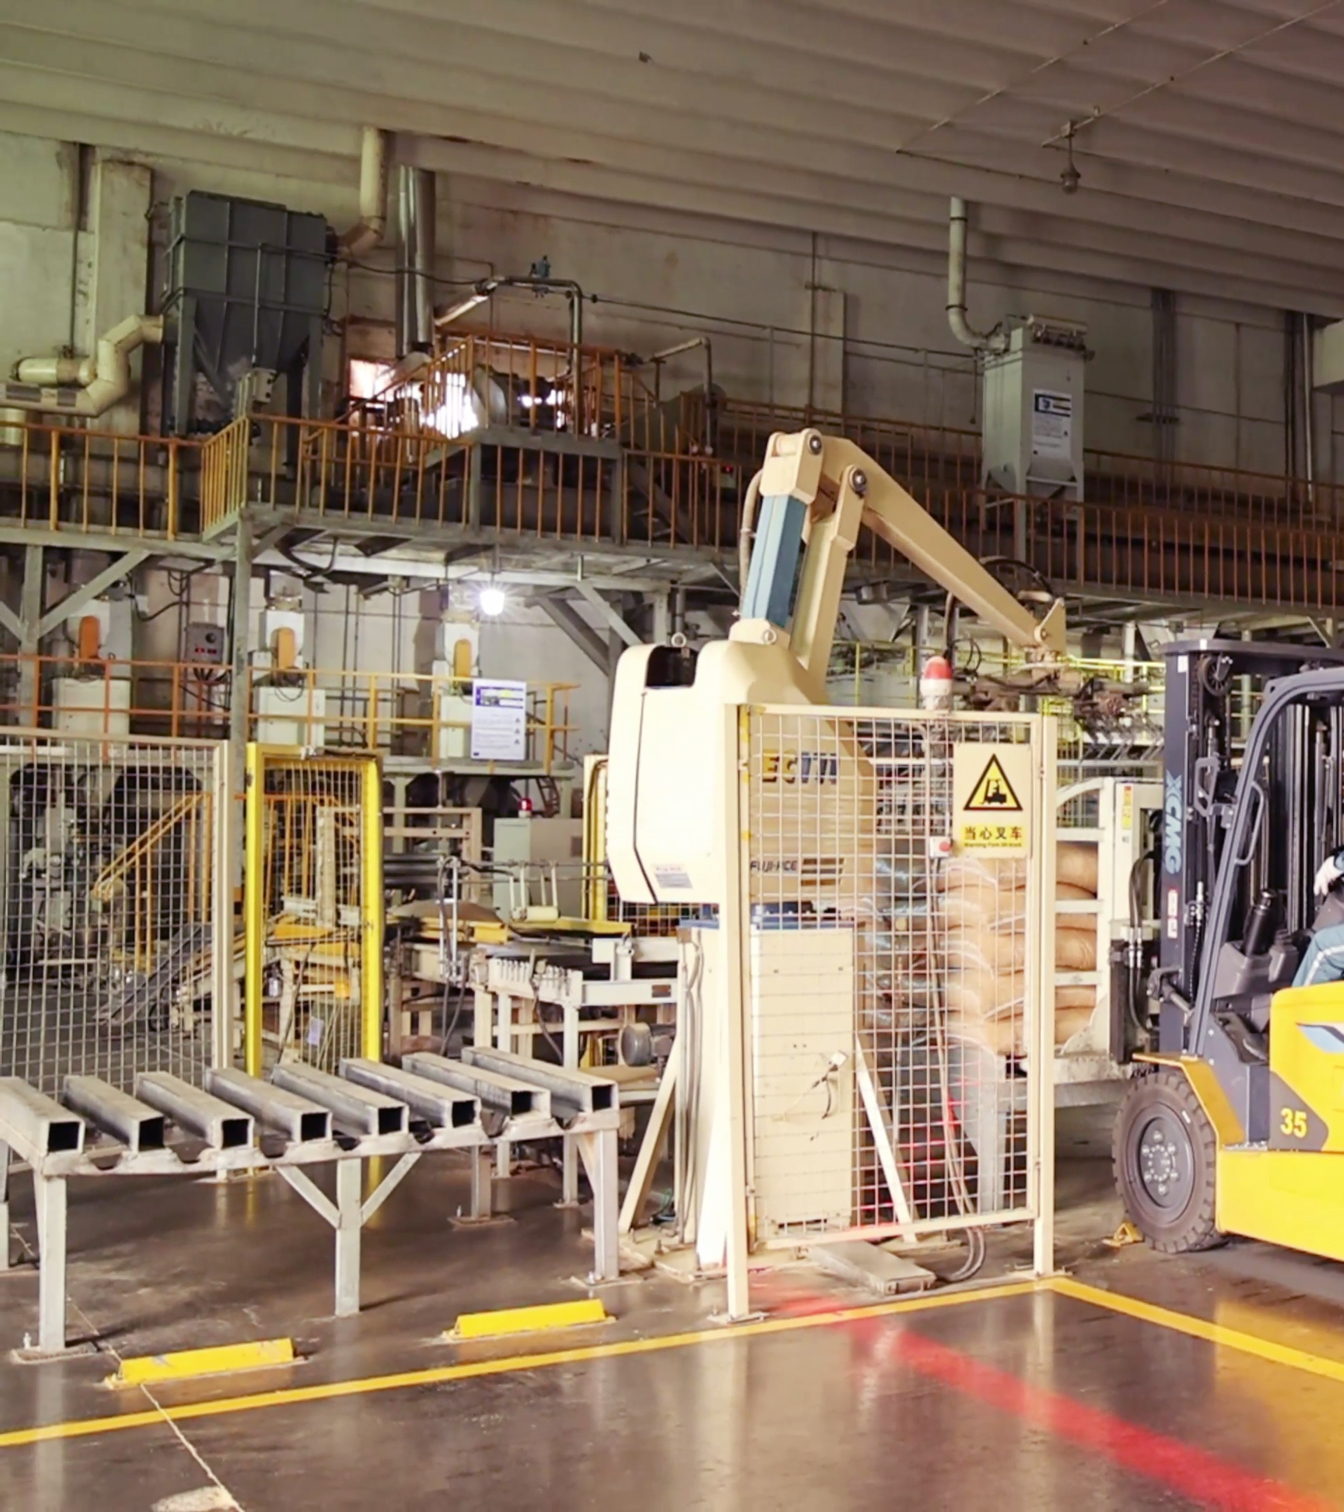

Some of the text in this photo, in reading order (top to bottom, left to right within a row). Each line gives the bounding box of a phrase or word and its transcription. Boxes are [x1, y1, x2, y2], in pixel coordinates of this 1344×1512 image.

[964, 826, 1022, 840] 当心叉车
[1165, 769, 1183, 875] XCMG
[1280, 1108, 1307, 1138] 35
